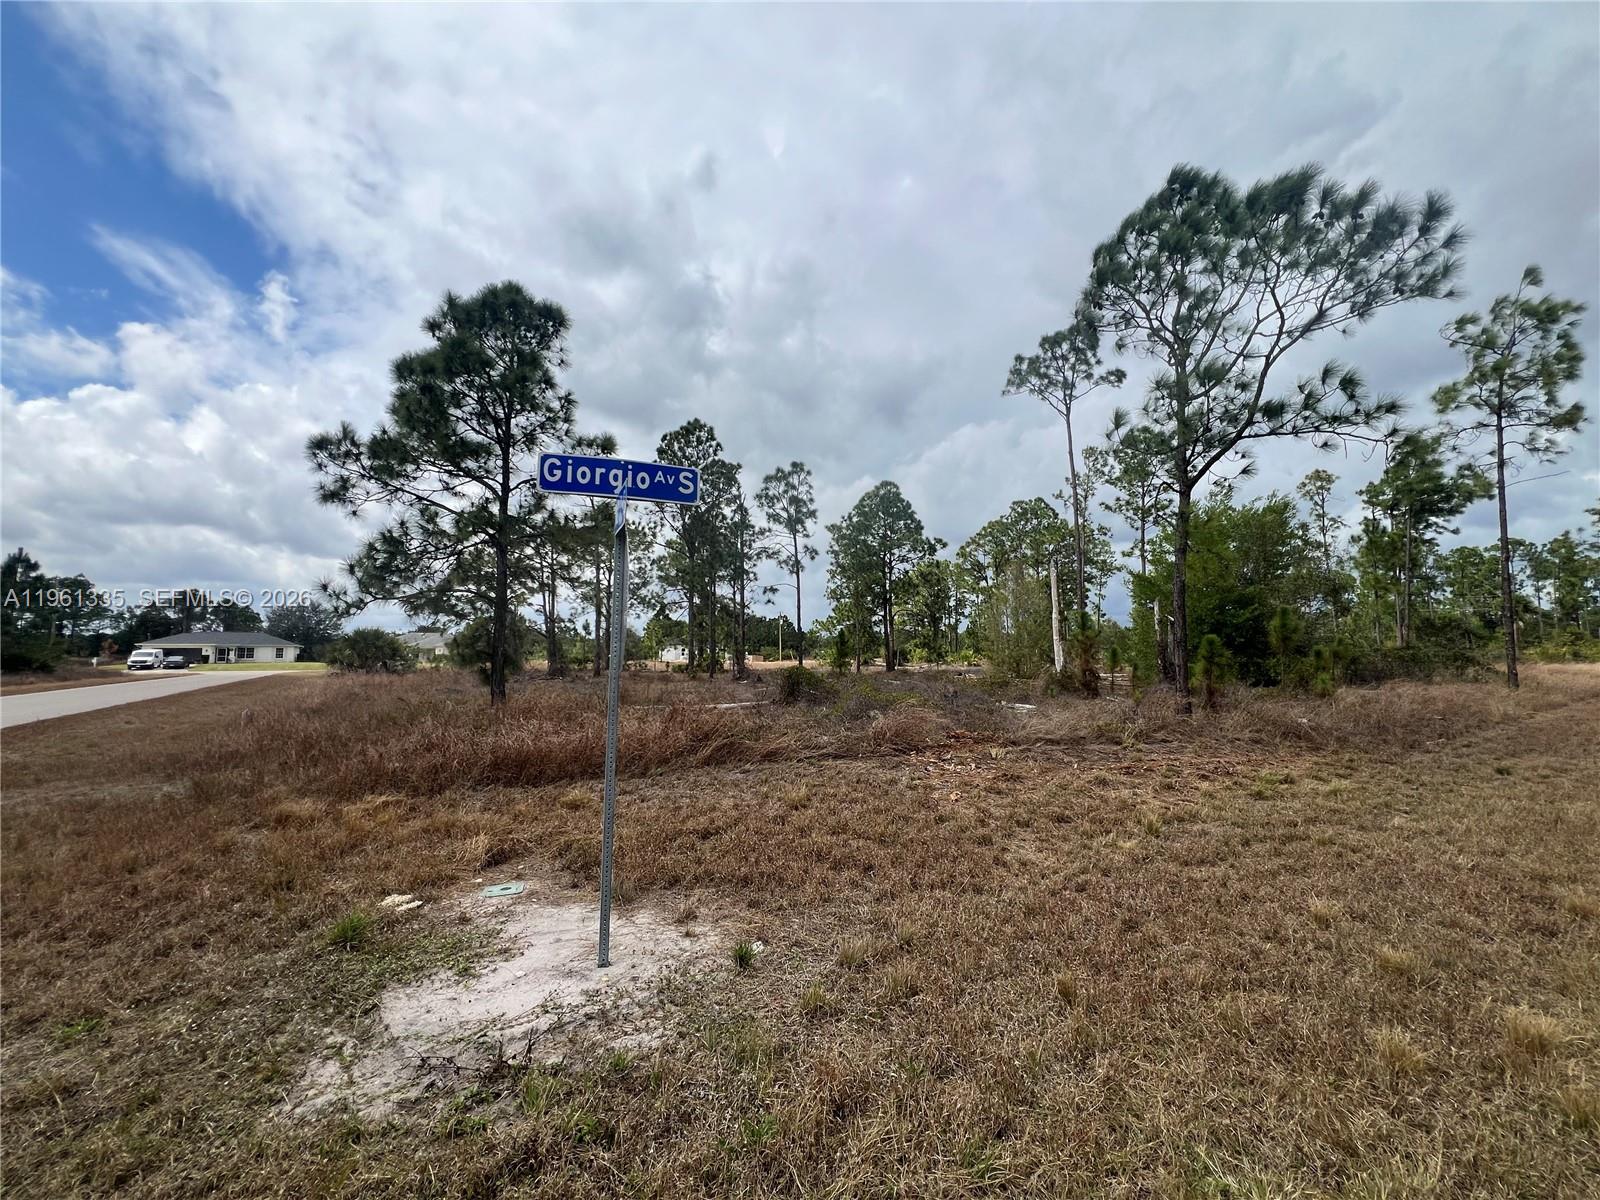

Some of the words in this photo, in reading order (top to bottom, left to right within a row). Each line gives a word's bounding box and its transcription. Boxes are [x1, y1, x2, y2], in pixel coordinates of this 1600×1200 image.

[543, 457, 650, 494] Giorgio
[654, 470, 675, 485] Av
[678, 471, 694, 494] S
